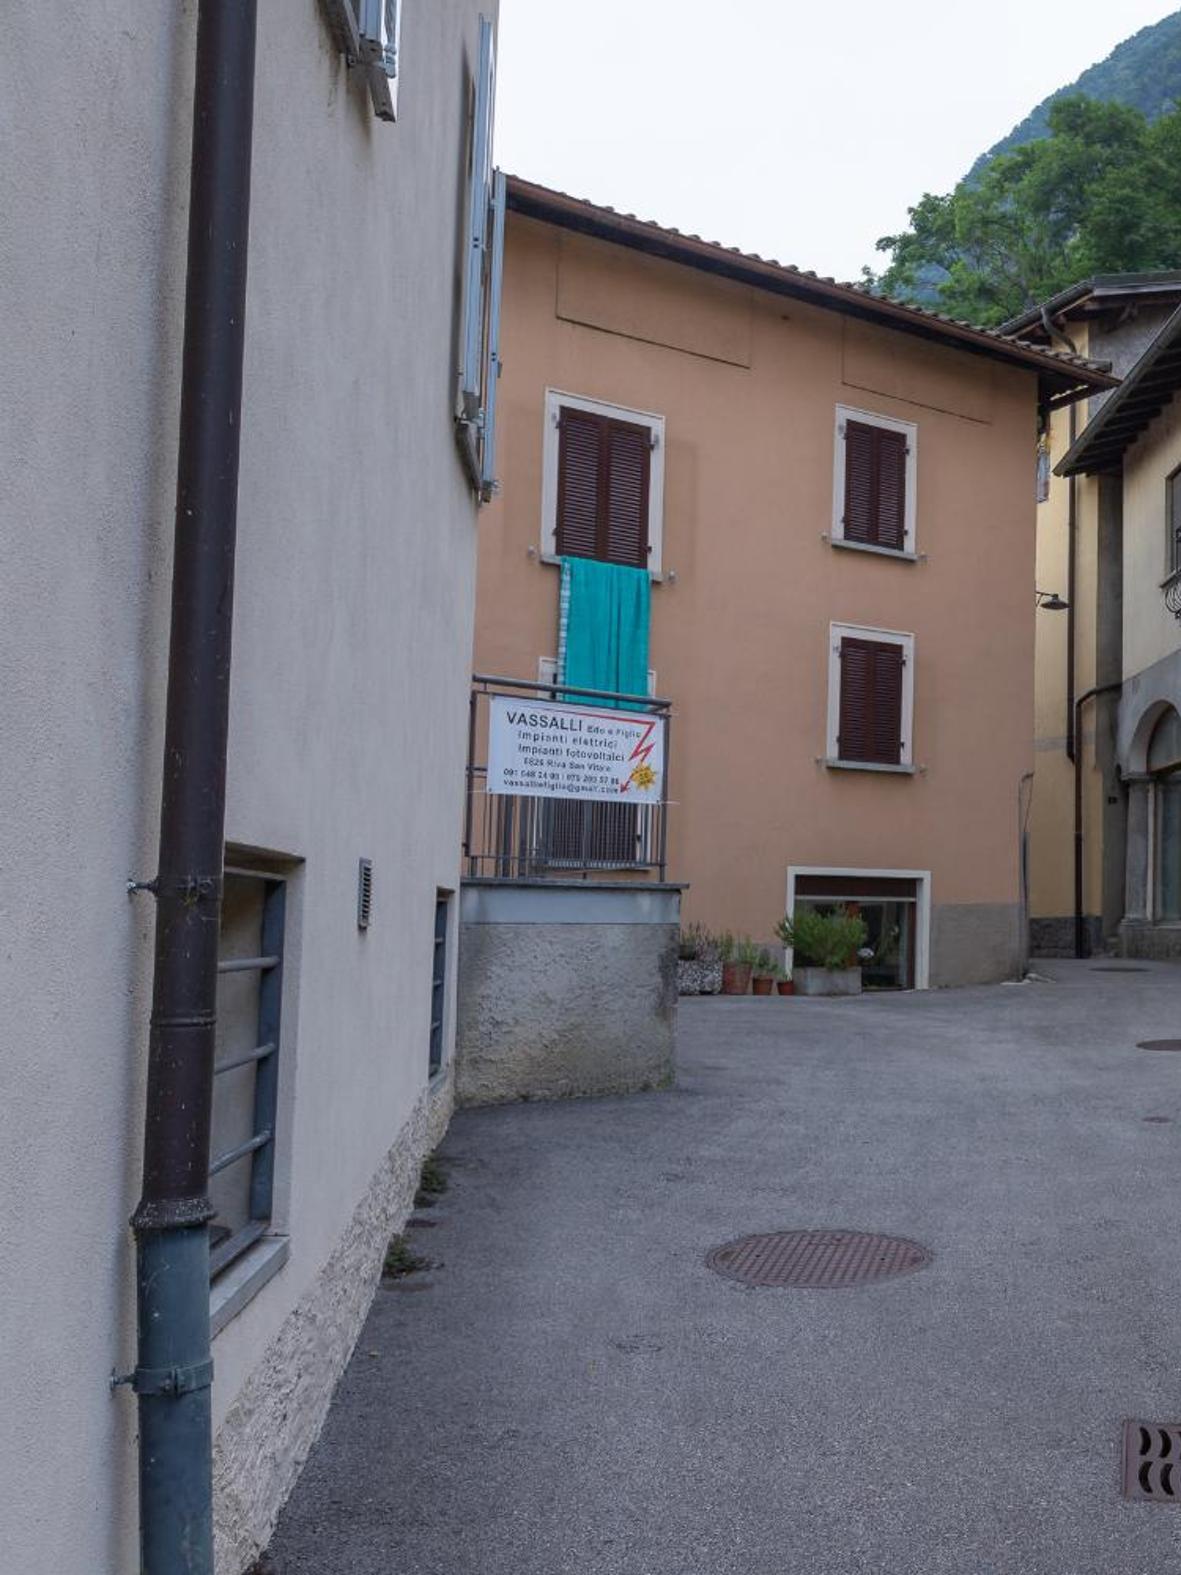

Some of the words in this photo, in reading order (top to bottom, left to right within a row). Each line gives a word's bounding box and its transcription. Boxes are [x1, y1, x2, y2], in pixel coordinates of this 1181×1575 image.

[506, 711, 582, 732] VASSALLI
[518, 730, 568, 745] Impianti
[572, 736, 618, 748] elettrici
[518, 743, 563, 756] Impianti
[566, 747, 625, 762] fotovoltaici
[547, 760, 566, 769] Riva
